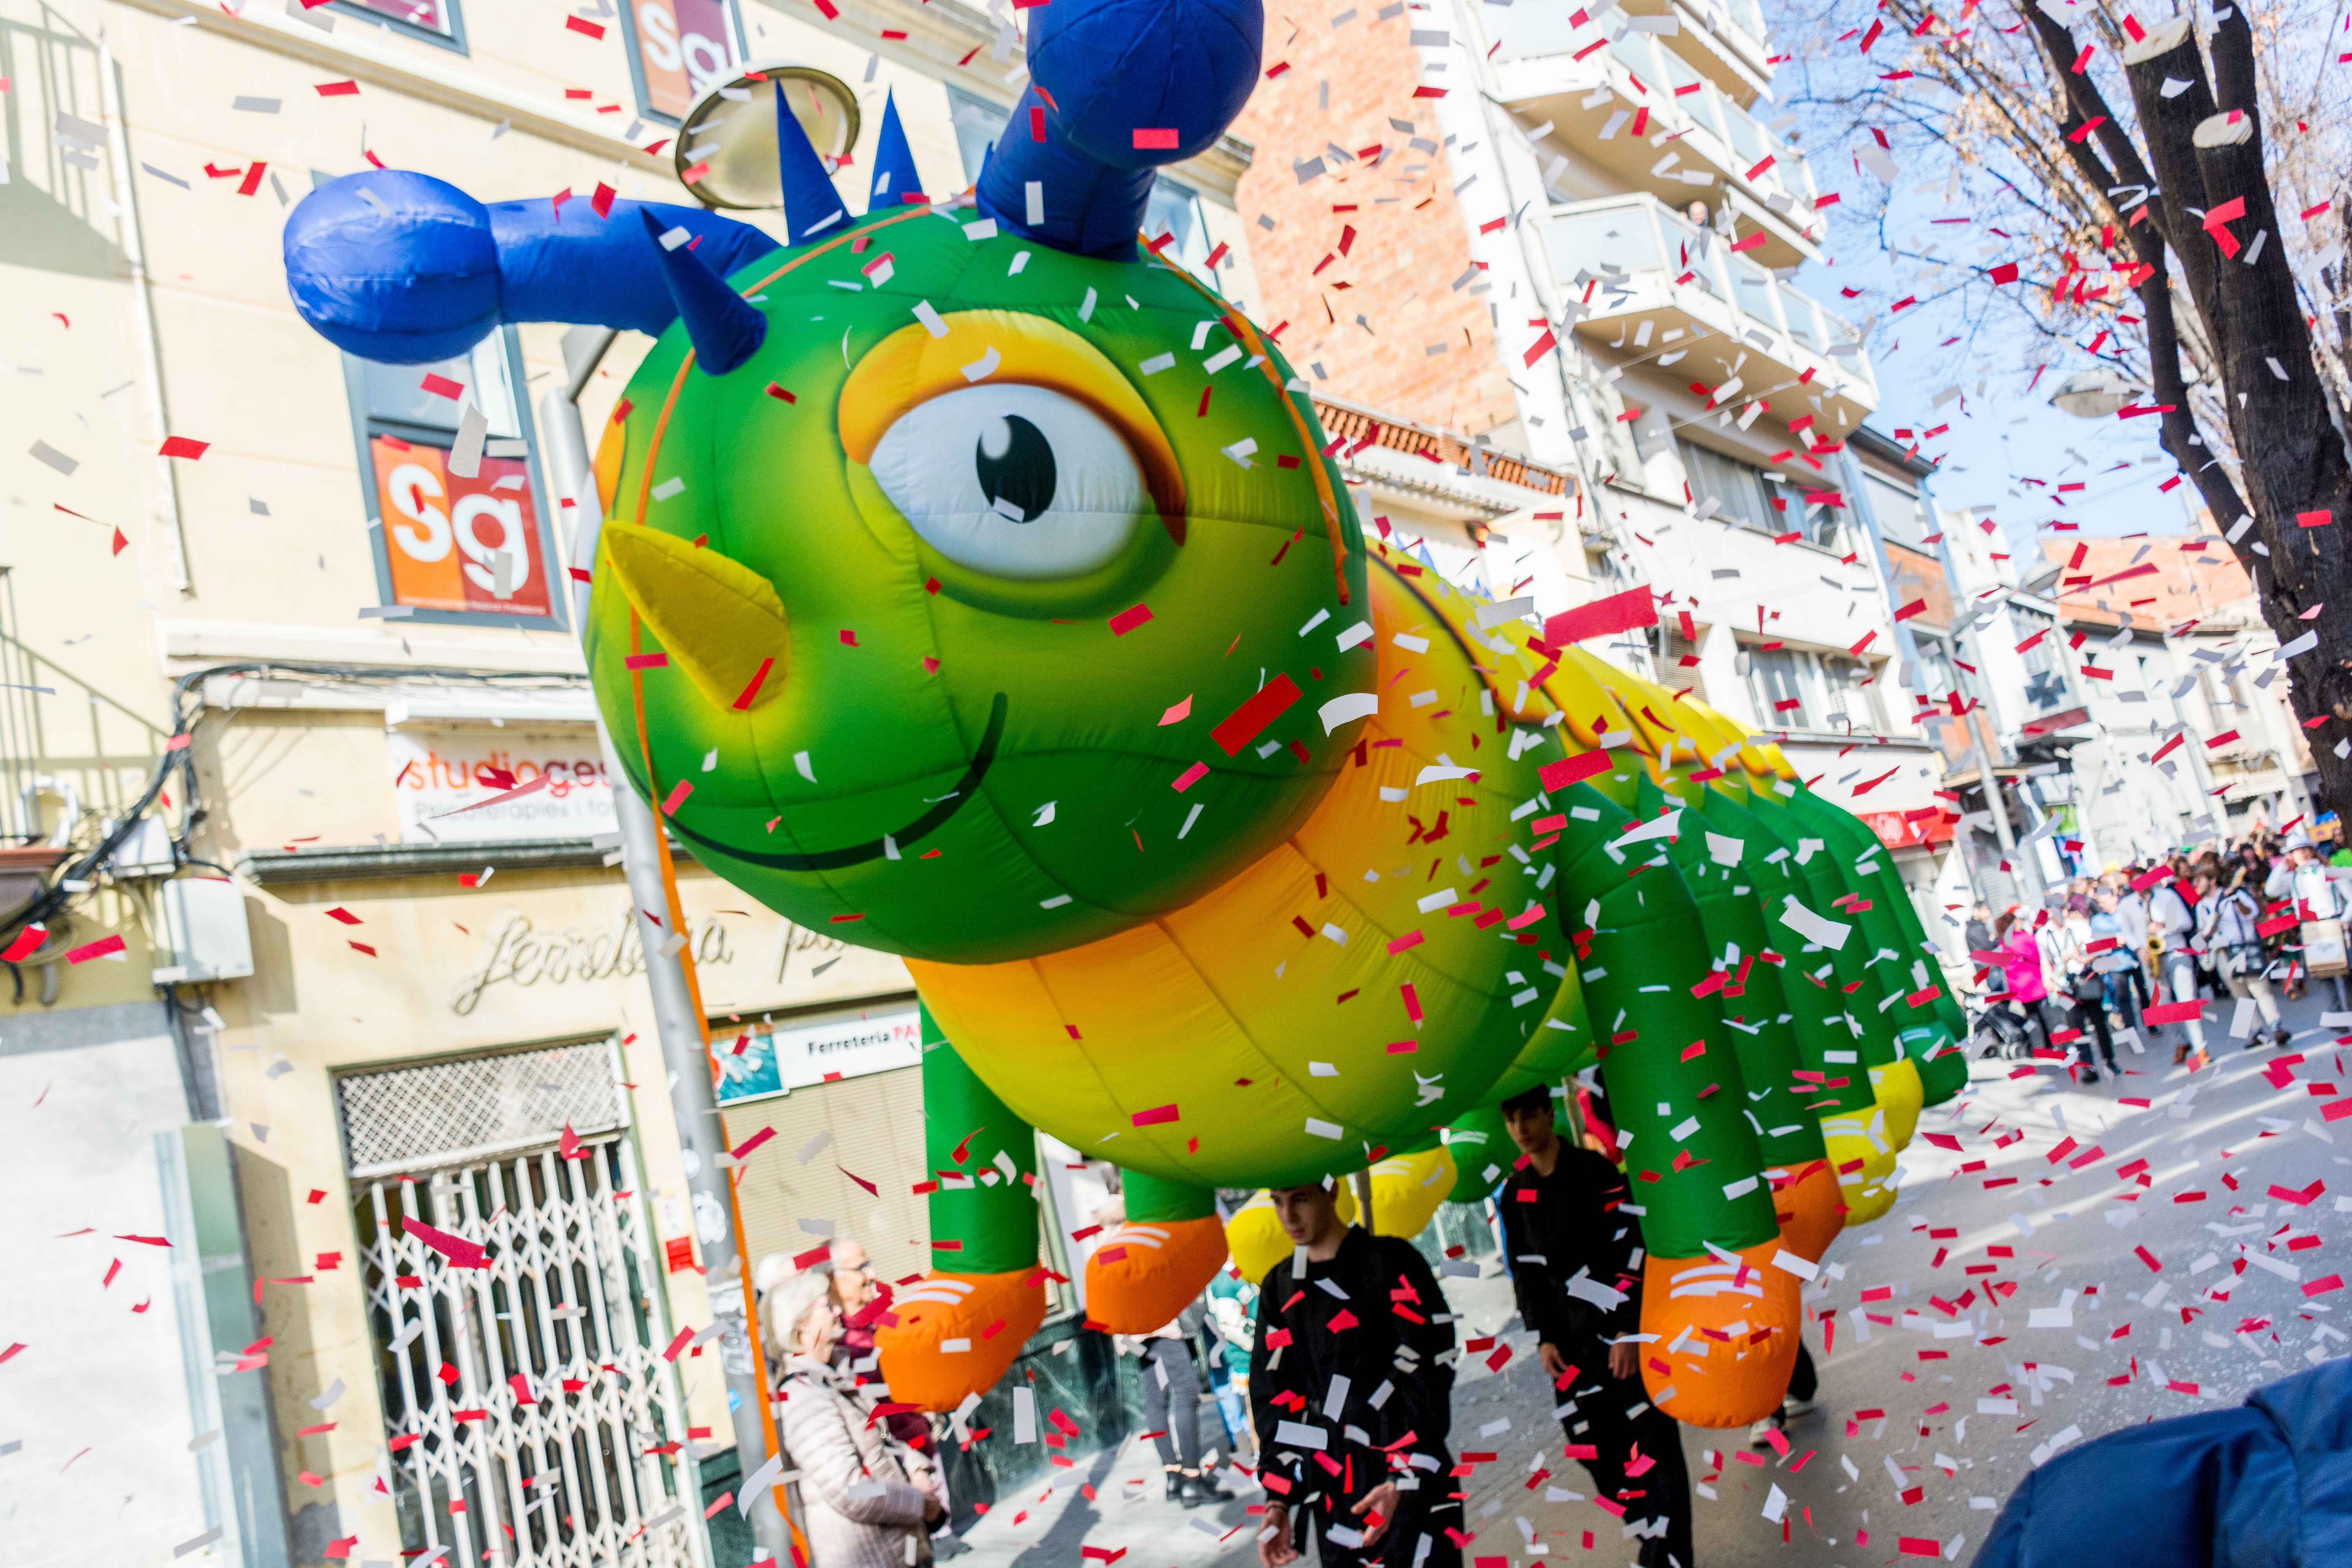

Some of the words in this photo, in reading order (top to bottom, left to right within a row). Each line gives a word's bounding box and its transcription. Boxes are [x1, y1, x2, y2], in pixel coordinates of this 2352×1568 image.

[388, 464, 529, 593] Sg
[808, 1031, 890, 1054] Ferreteria
[894, 1024, 921, 1040] PA
